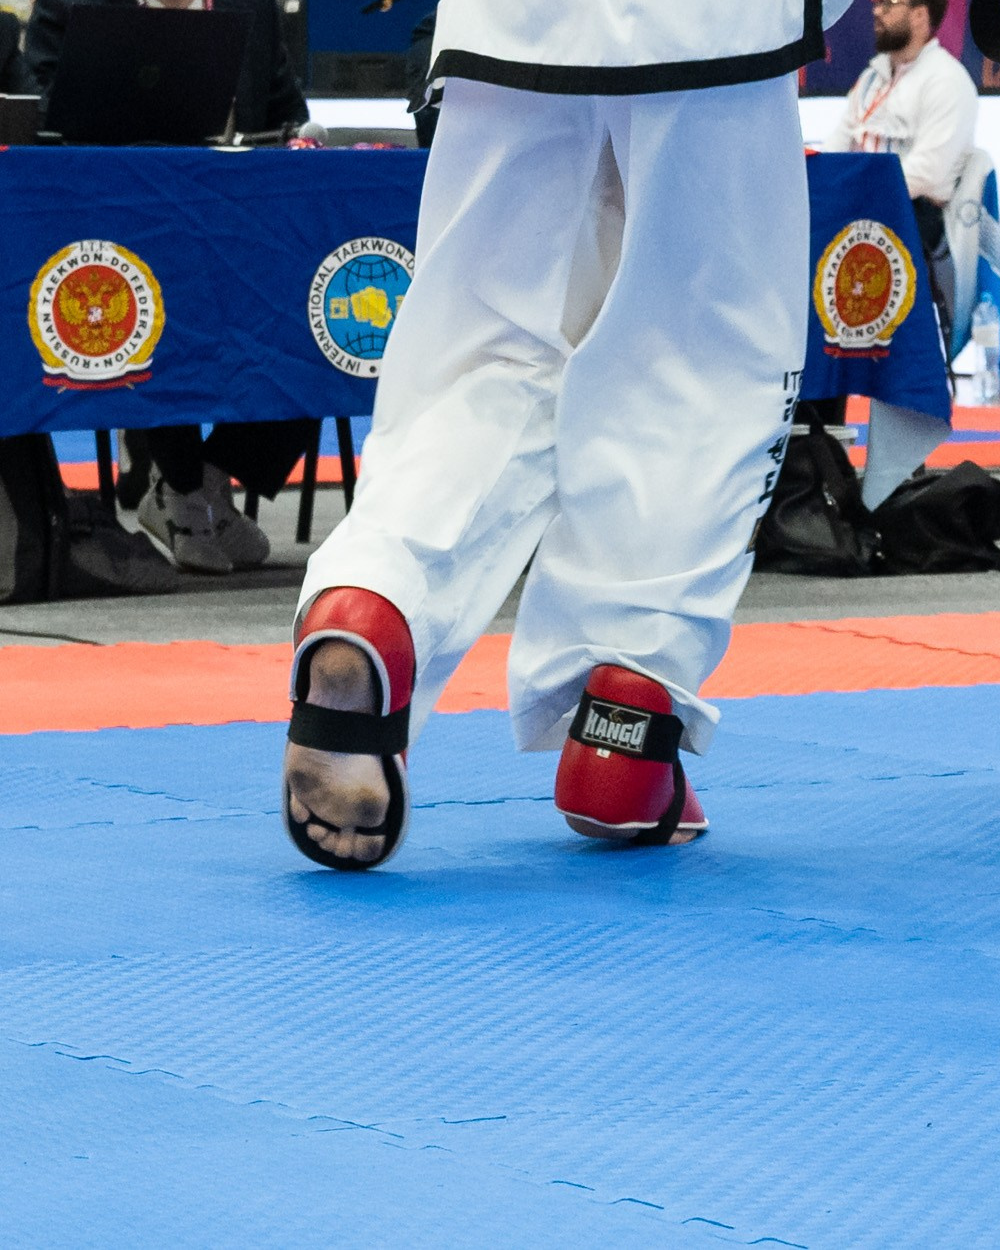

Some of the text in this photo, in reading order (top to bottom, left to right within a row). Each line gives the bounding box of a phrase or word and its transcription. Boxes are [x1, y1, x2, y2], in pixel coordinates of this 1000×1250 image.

[42, 253, 149, 369] RUSSIAN TAEKWON-DO FEDERATION
[311, 239, 415, 373] INTERNATIONAL TAEKWON-D
[585, 707, 648, 746] KANGO
